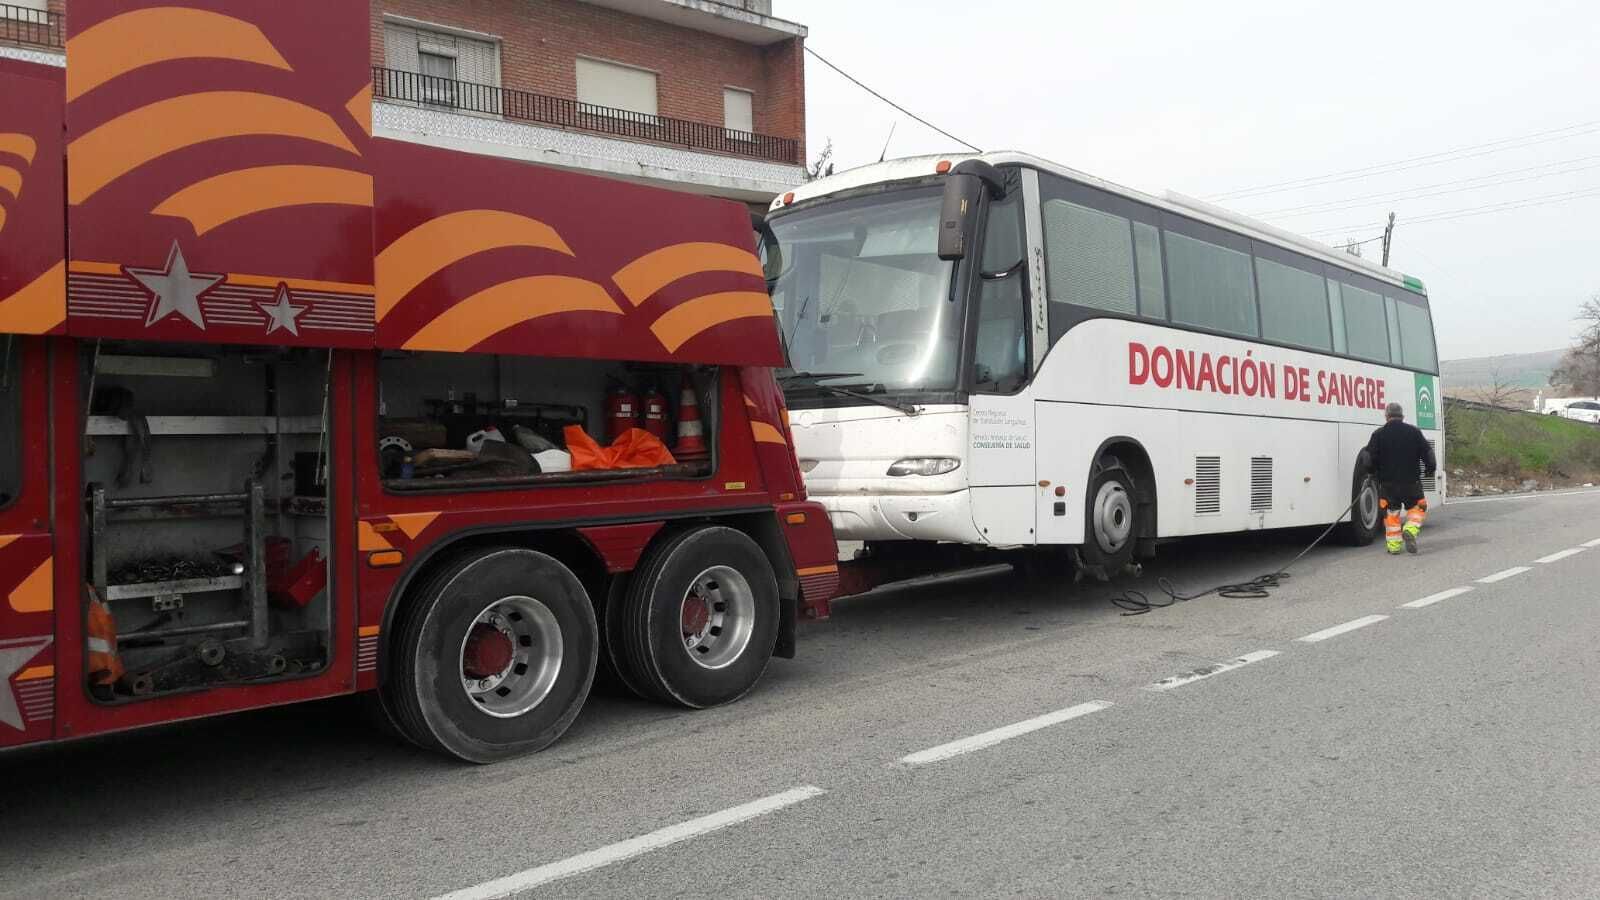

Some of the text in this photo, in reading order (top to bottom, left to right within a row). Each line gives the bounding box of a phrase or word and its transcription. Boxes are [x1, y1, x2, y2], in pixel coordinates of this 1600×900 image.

[1128, 342, 1386, 410] DONACIÓN DE SANGRE
